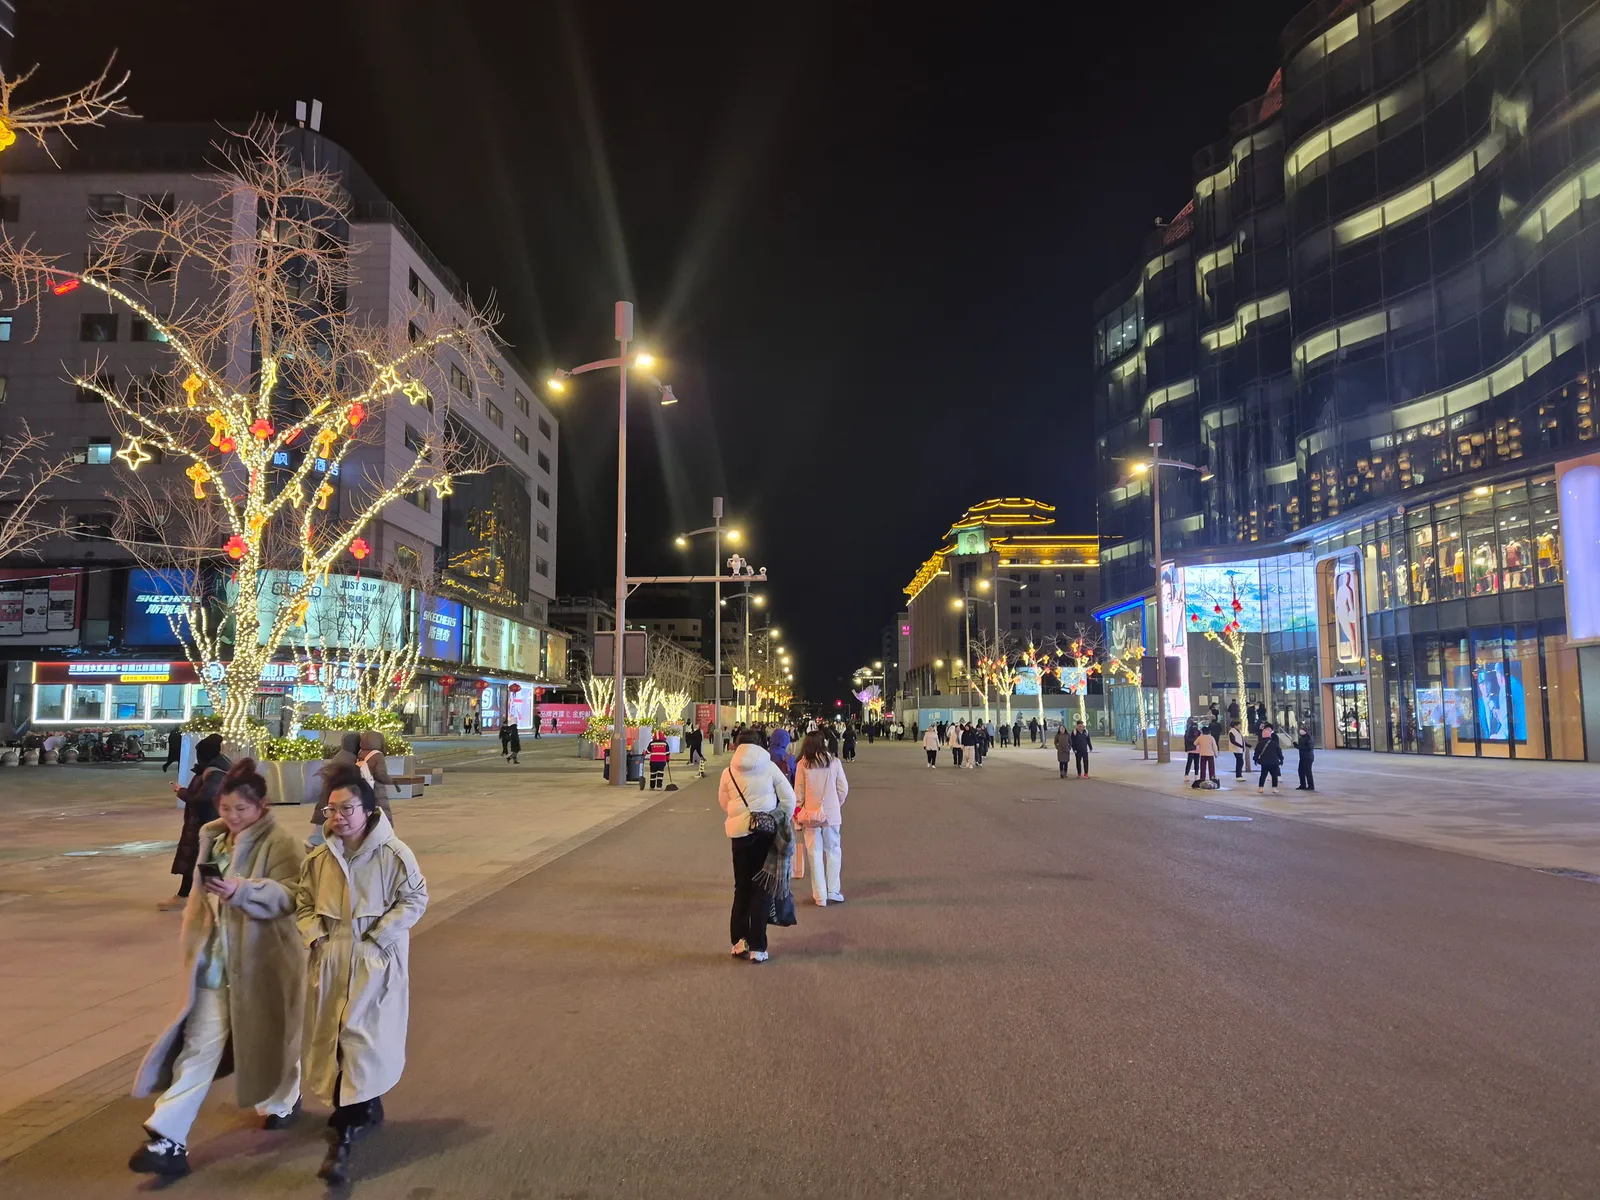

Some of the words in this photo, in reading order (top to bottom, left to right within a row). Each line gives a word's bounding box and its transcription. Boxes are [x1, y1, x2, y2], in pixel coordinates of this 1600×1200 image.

[340, 580, 359, 591] JUST
[362, 582, 377, 593] SLIP
[136, 595, 201, 603] SKECHERS
[423, 610, 457, 628] SKECHERS
[428, 625, 451, 642] 斯凯奇
